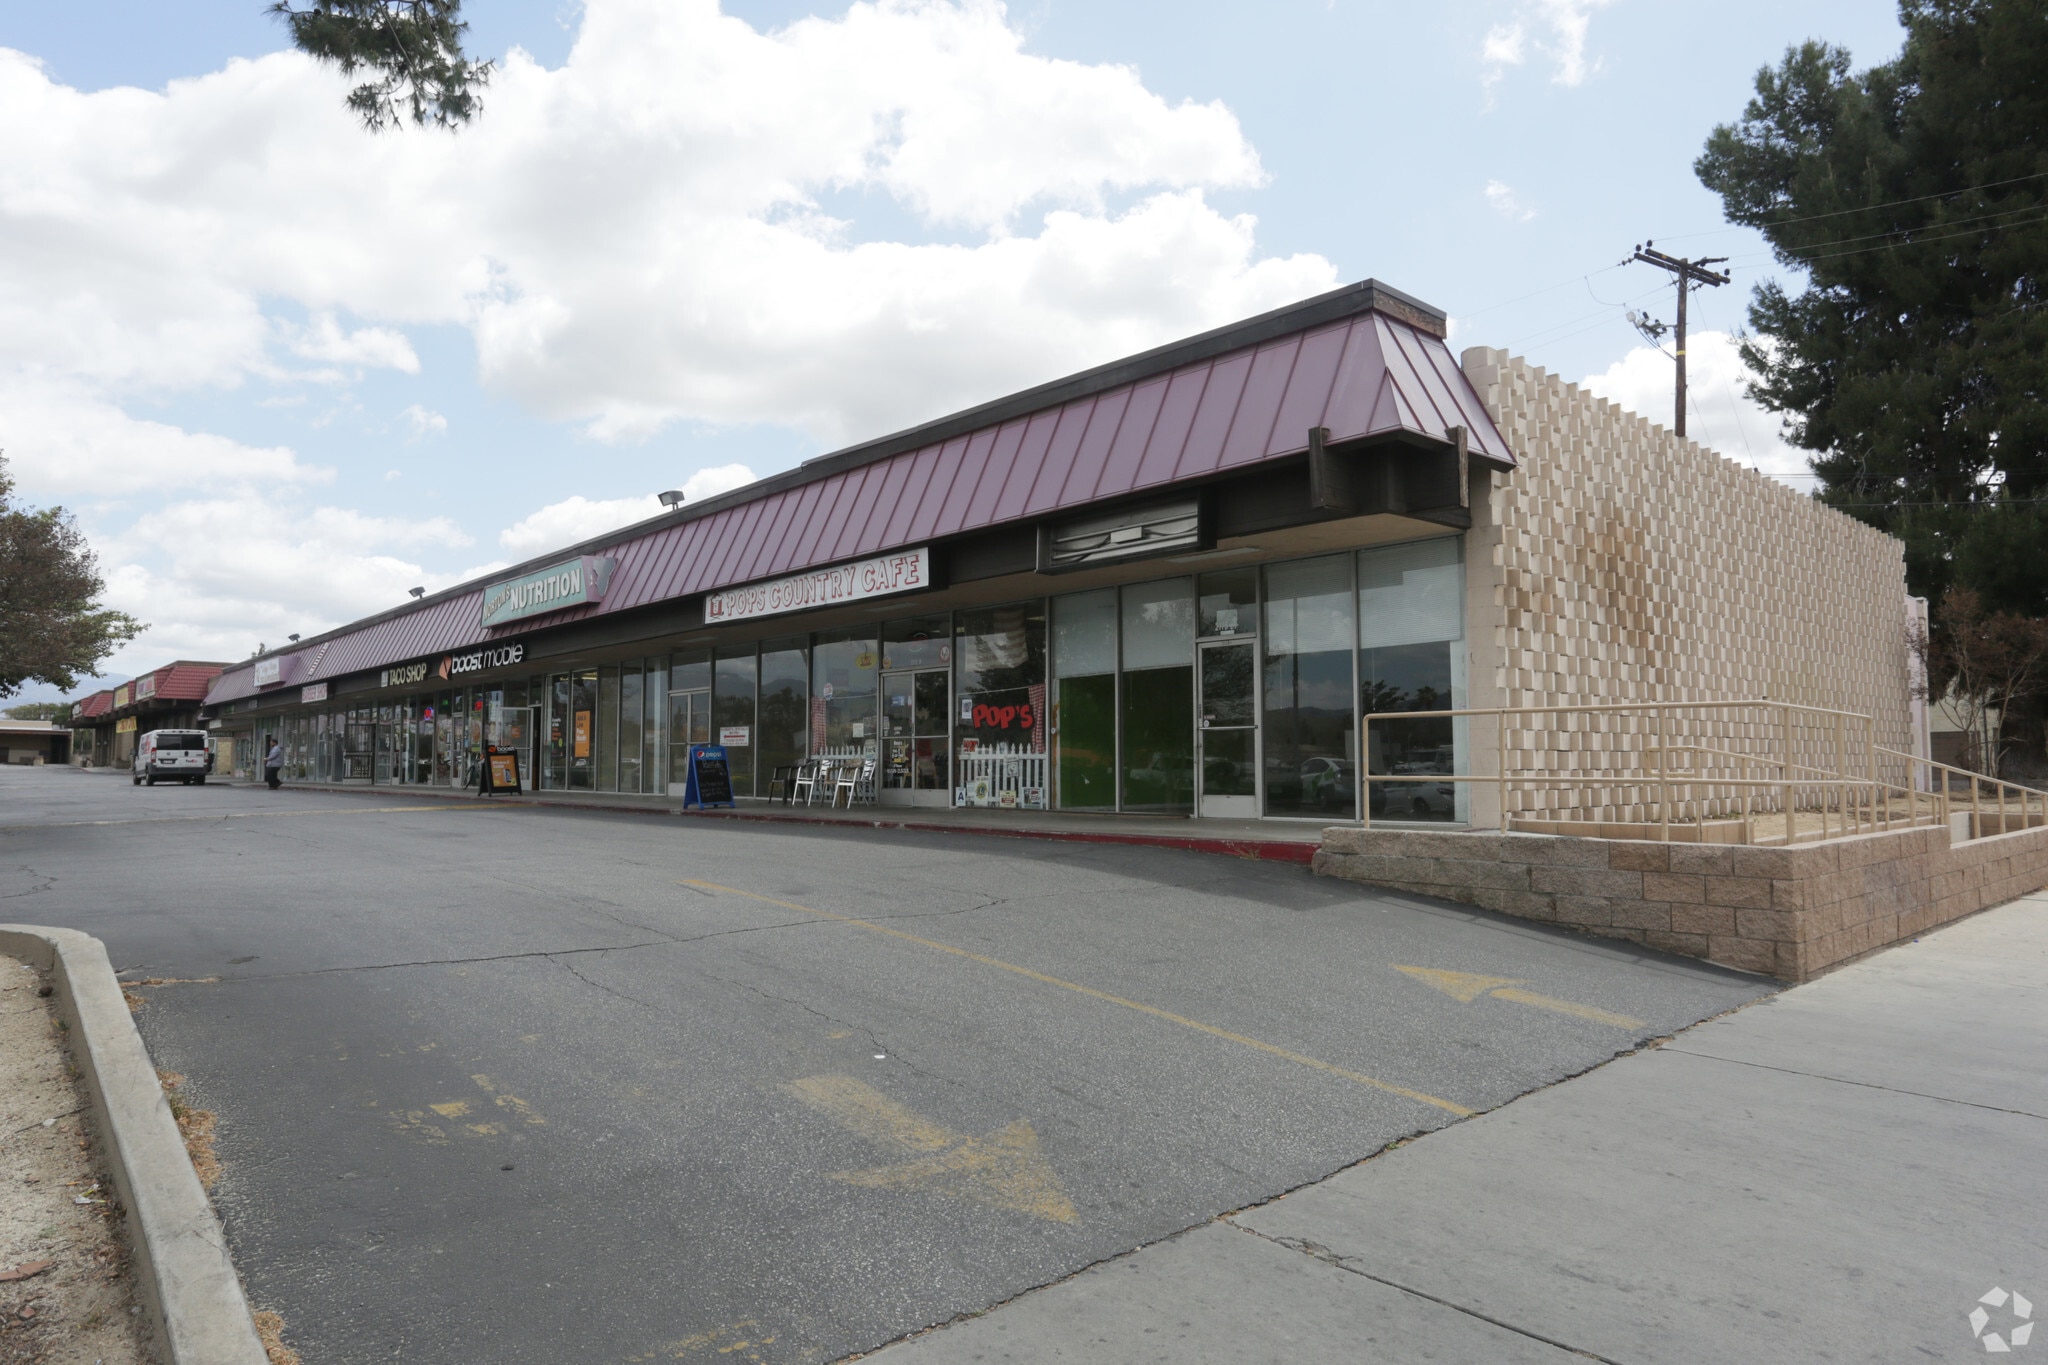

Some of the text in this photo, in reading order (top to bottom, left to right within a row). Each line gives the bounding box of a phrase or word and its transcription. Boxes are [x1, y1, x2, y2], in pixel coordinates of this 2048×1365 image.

[510, 567, 581, 612] NUTRITION
[769, 566, 857, 609] COUNTRY
[861, 554, 920, 593] CAFE
[451, 641, 523, 674] boost mobile
[389, 667, 406, 686] TACO
[406, 662, 427, 684] SHOP
[972, 704, 1034, 729] POP'S
[957, 791, 964, 801] A
